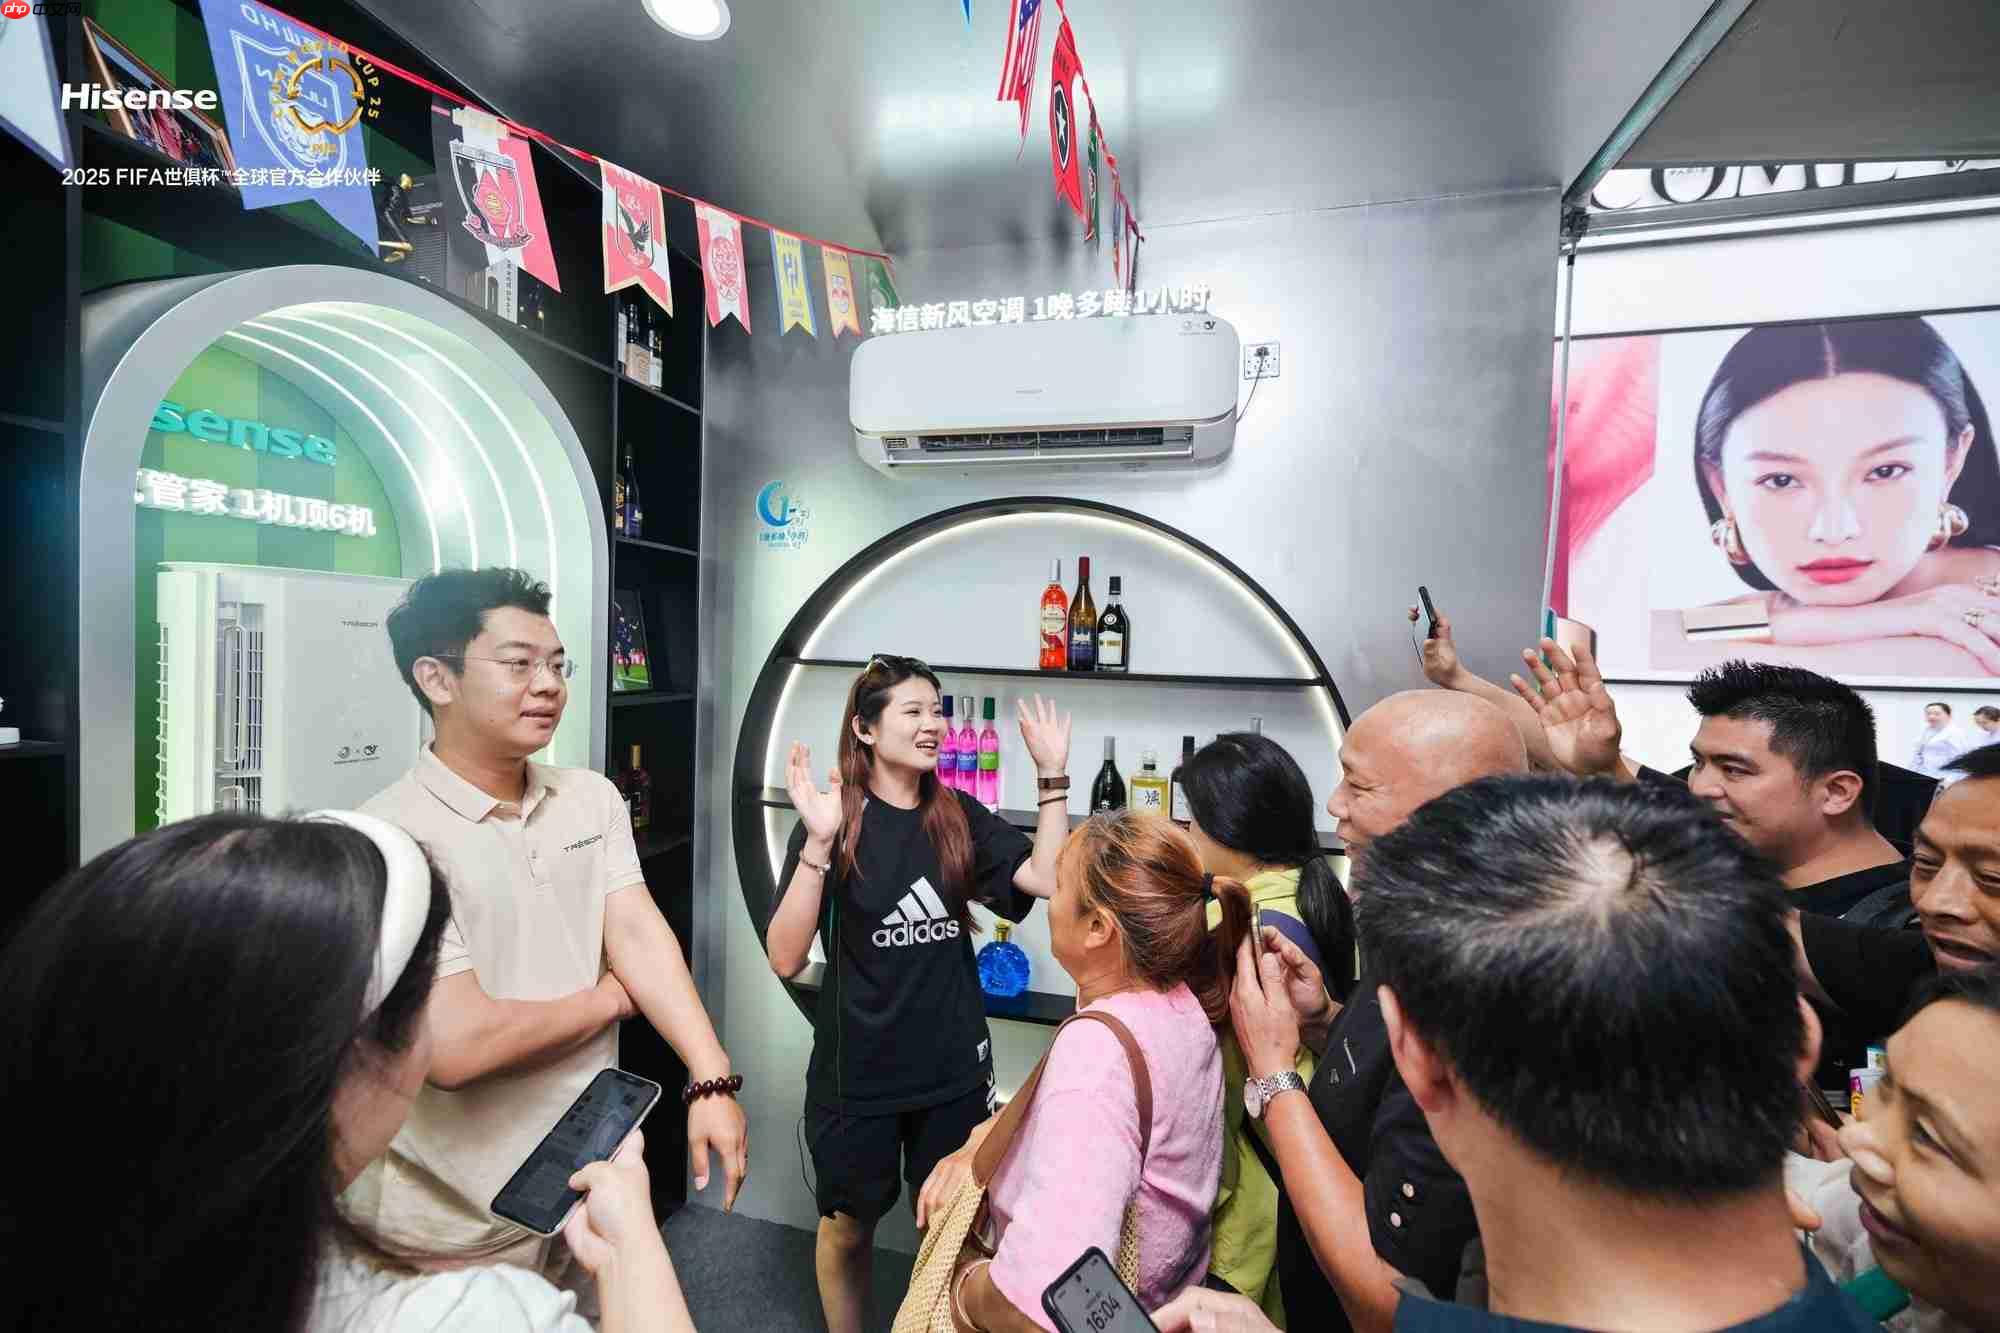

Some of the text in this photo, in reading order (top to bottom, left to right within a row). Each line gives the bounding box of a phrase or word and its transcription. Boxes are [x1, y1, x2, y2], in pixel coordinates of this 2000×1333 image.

[871, 296, 1025, 334] 海信新风空调
[134, 467, 230, 515] 管家
[872, 917, 961, 948] adidas
[1086, 1292, 1123, 1333] 16:04
